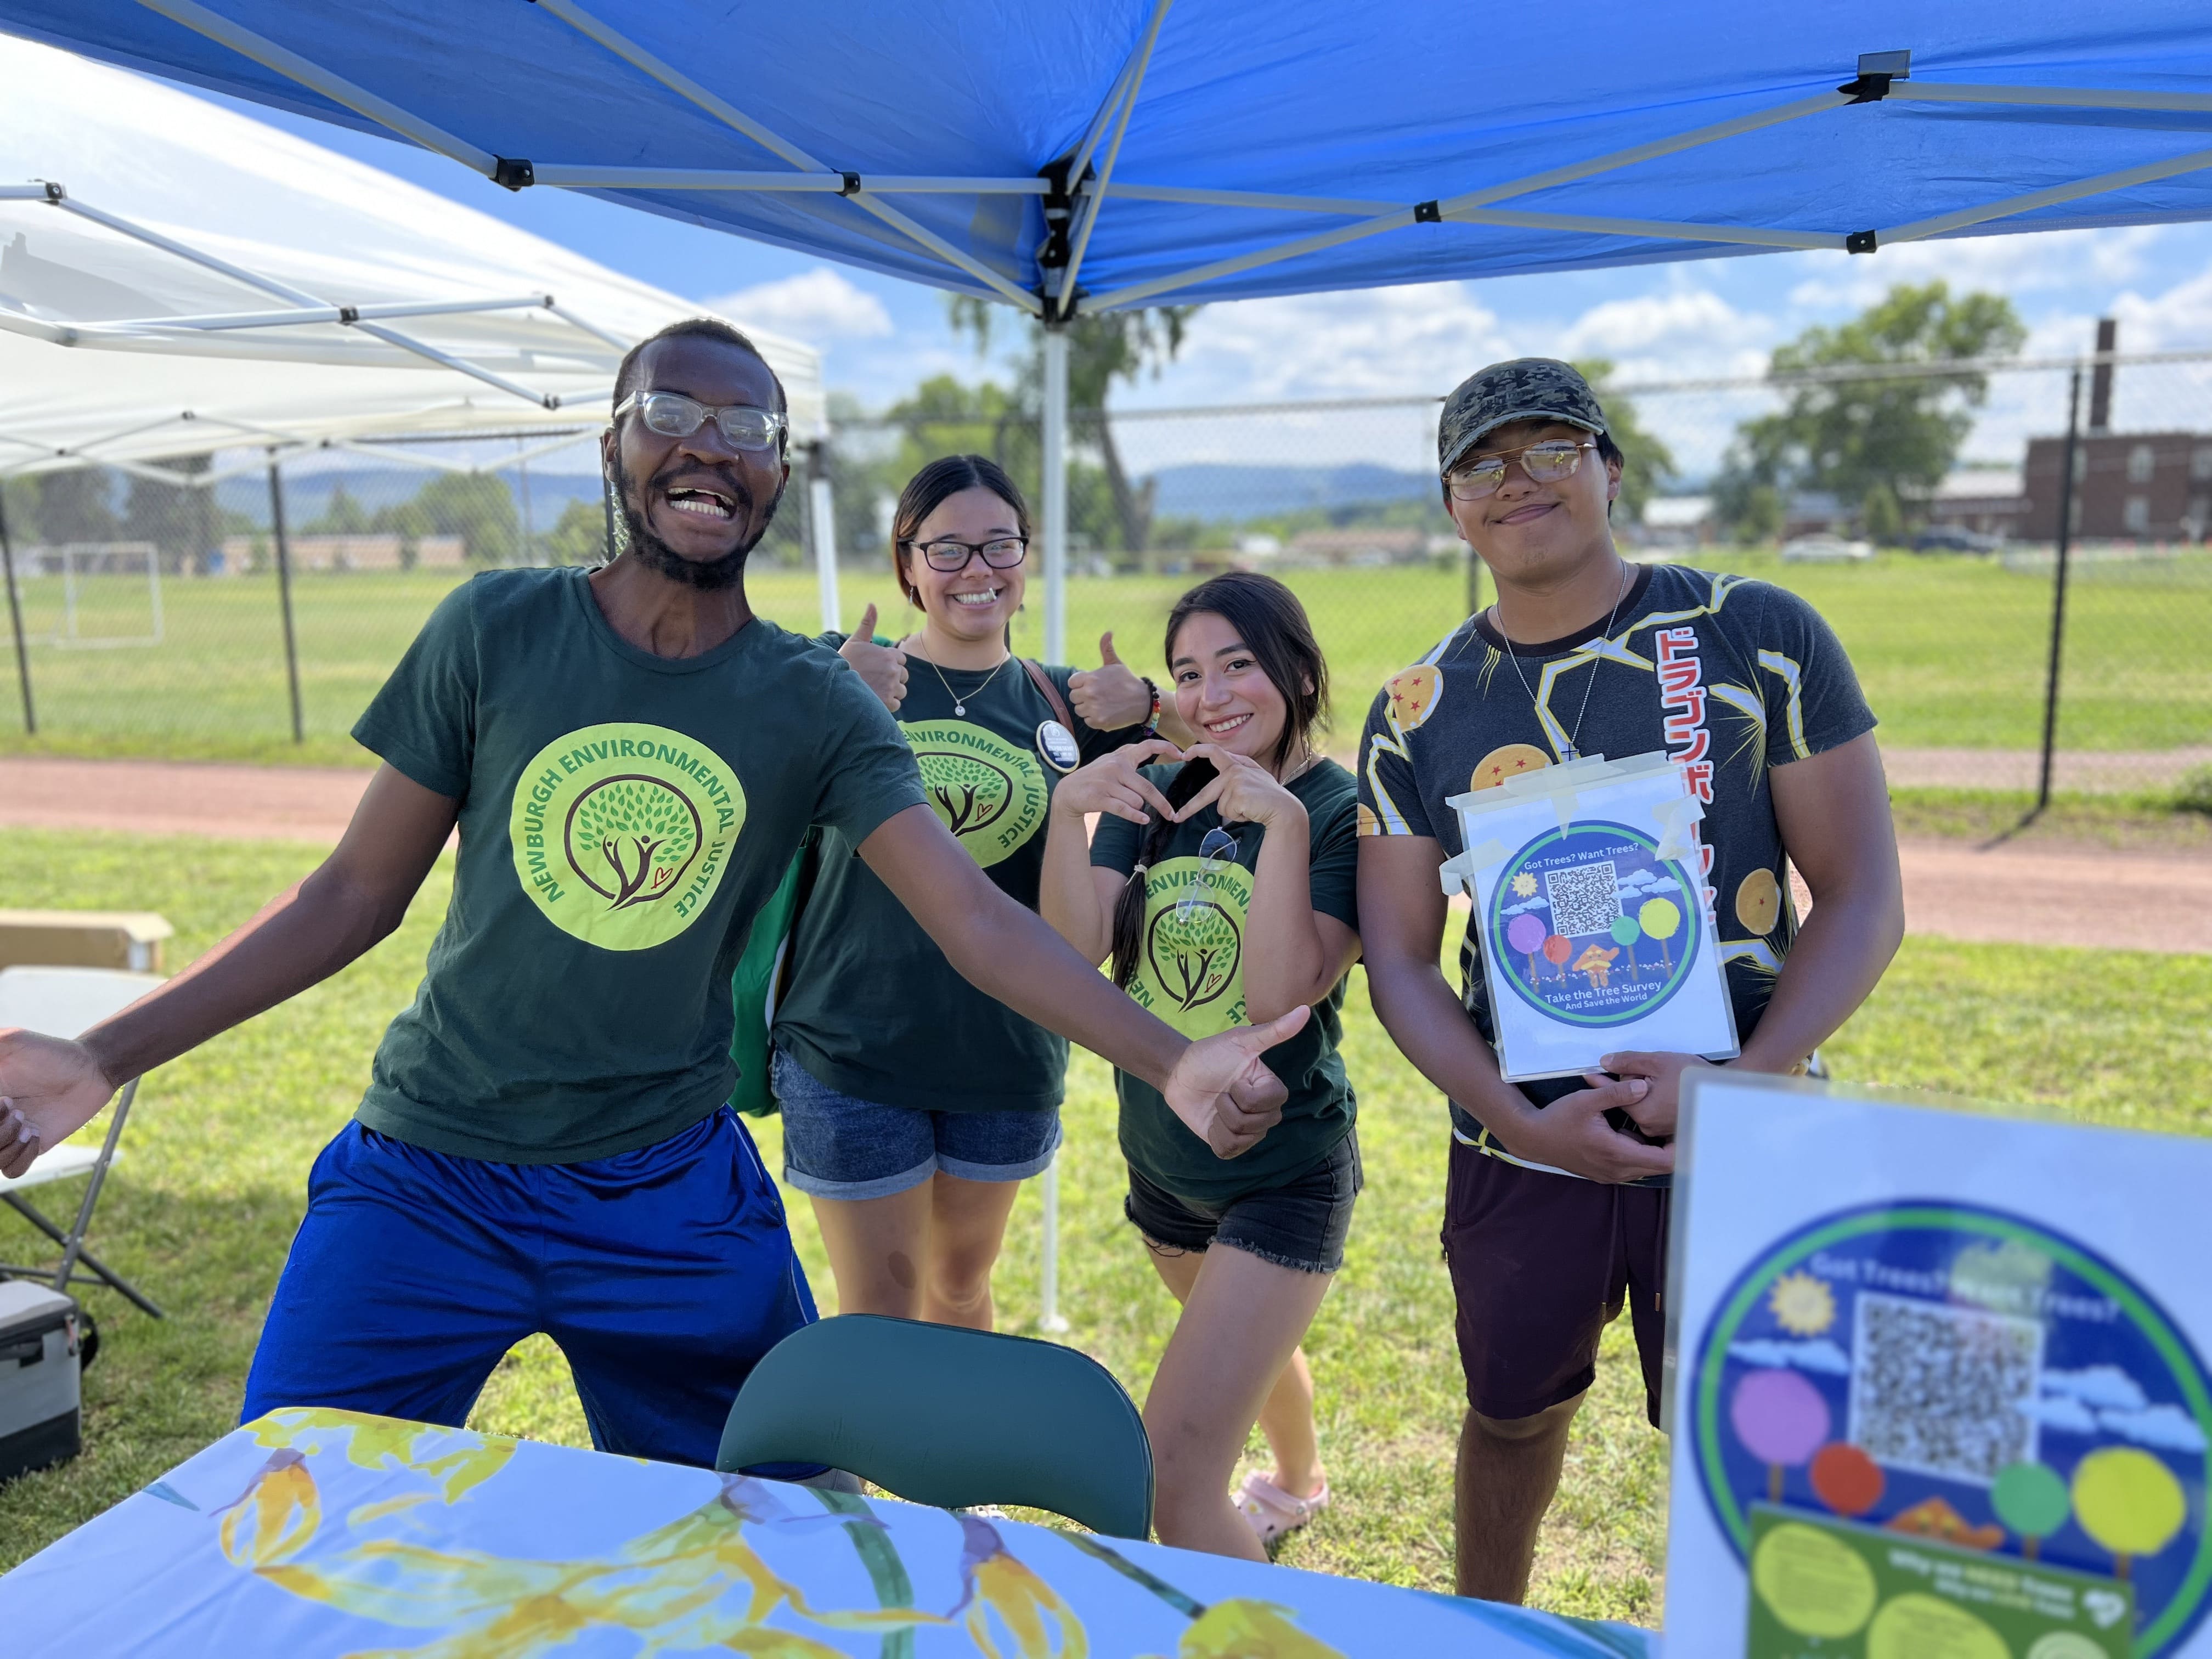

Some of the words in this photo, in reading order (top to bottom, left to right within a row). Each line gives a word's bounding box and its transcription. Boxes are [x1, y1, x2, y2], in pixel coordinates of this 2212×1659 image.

[524, 768, 565, 903] NEWBURGH
[558, 739, 735, 834] ENVIRONMENTAL
[674, 841, 726, 918] JUSTICE
[997, 784, 1039, 849] JUSTICE
[1524, 861, 1543, 870] Got
[1543, 853, 1576, 866] Trees?
[1577, 850, 1604, 861] Want
[1605, 842, 1639, 855] Trees?
[1545, 992, 1572, 1003] Take
[1573, 990, 1593, 1000] the
[1594, 987, 1620, 997] Tree
[1622, 981, 1662, 994] Survey
[1565, 1001, 1582, 1010] And
[1584, 999, 1604, 1008] Save
[1605, 996, 1620, 1005] the
[1621, 992, 1648, 1003] World
[1811, 1253, 1857, 1282] Got
[1863, 1259, 1948, 1294] Trees?
